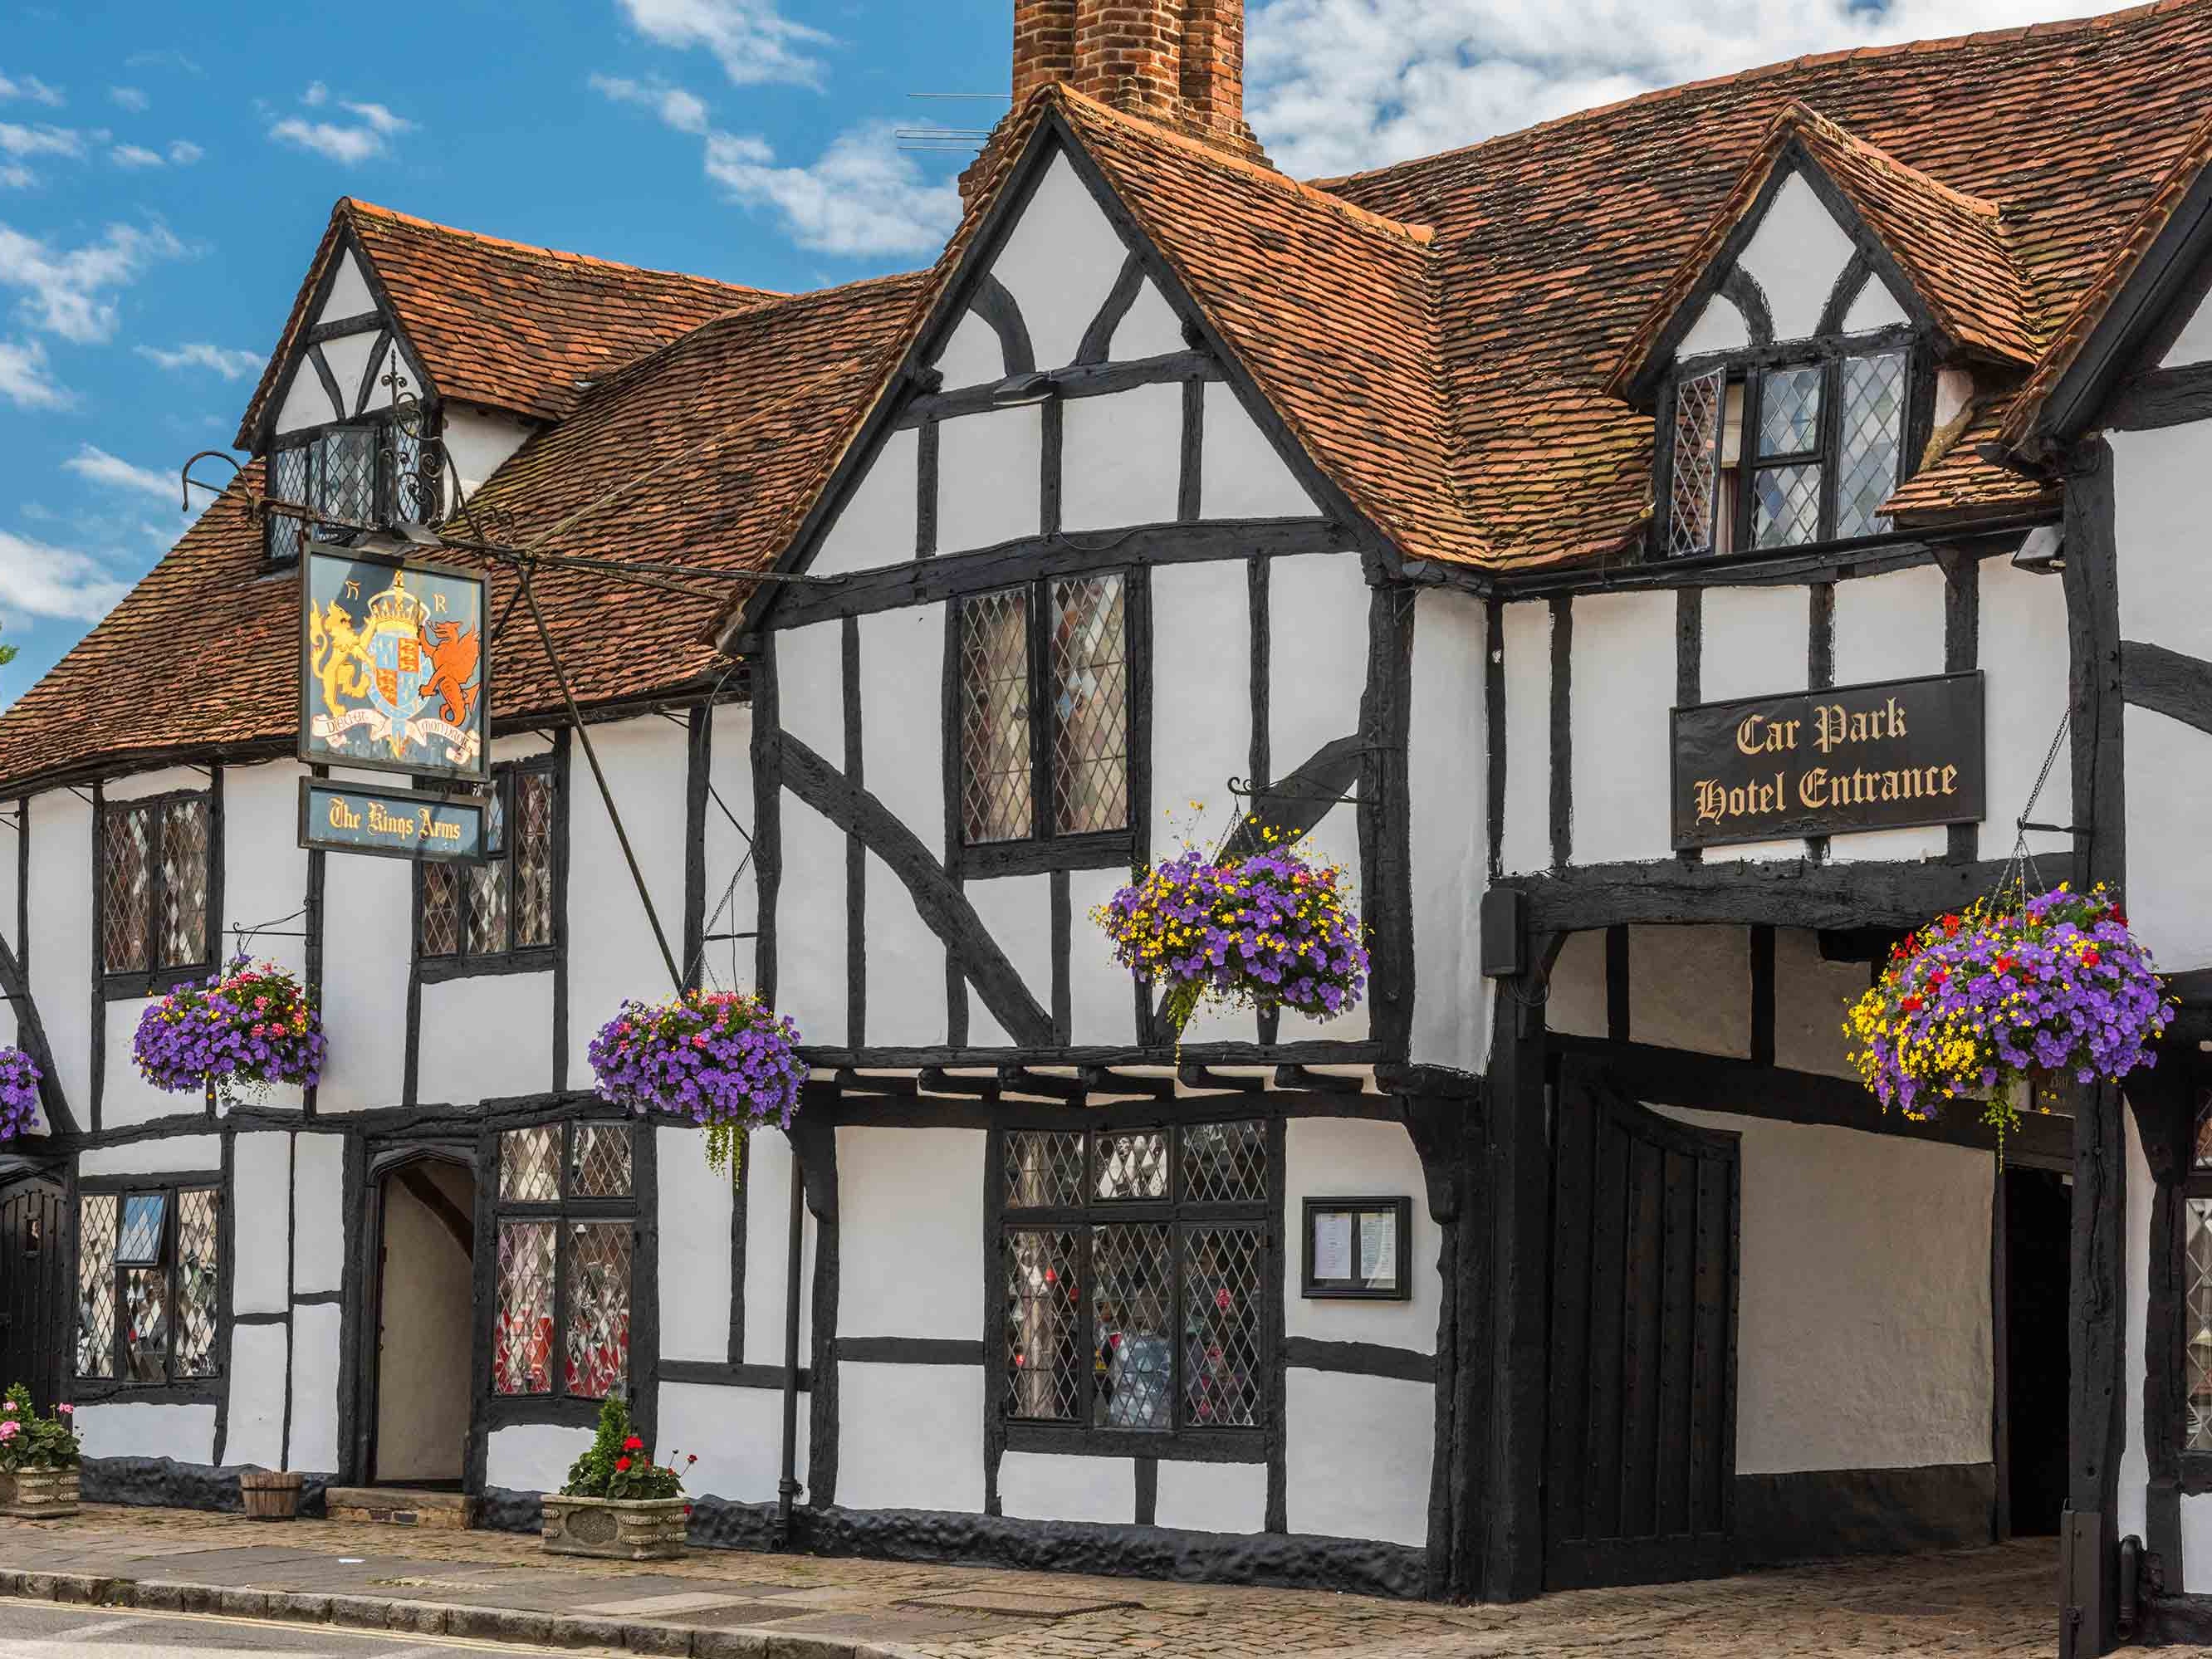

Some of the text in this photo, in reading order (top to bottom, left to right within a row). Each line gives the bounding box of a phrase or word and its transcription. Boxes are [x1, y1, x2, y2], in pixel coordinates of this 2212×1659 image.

[432, 593, 447, 614] R
[1736, 697, 1908, 756] Car Park
[329, 797, 461, 840] The Kings Arms
[1693, 762, 1959, 827] Hotel Entrance
